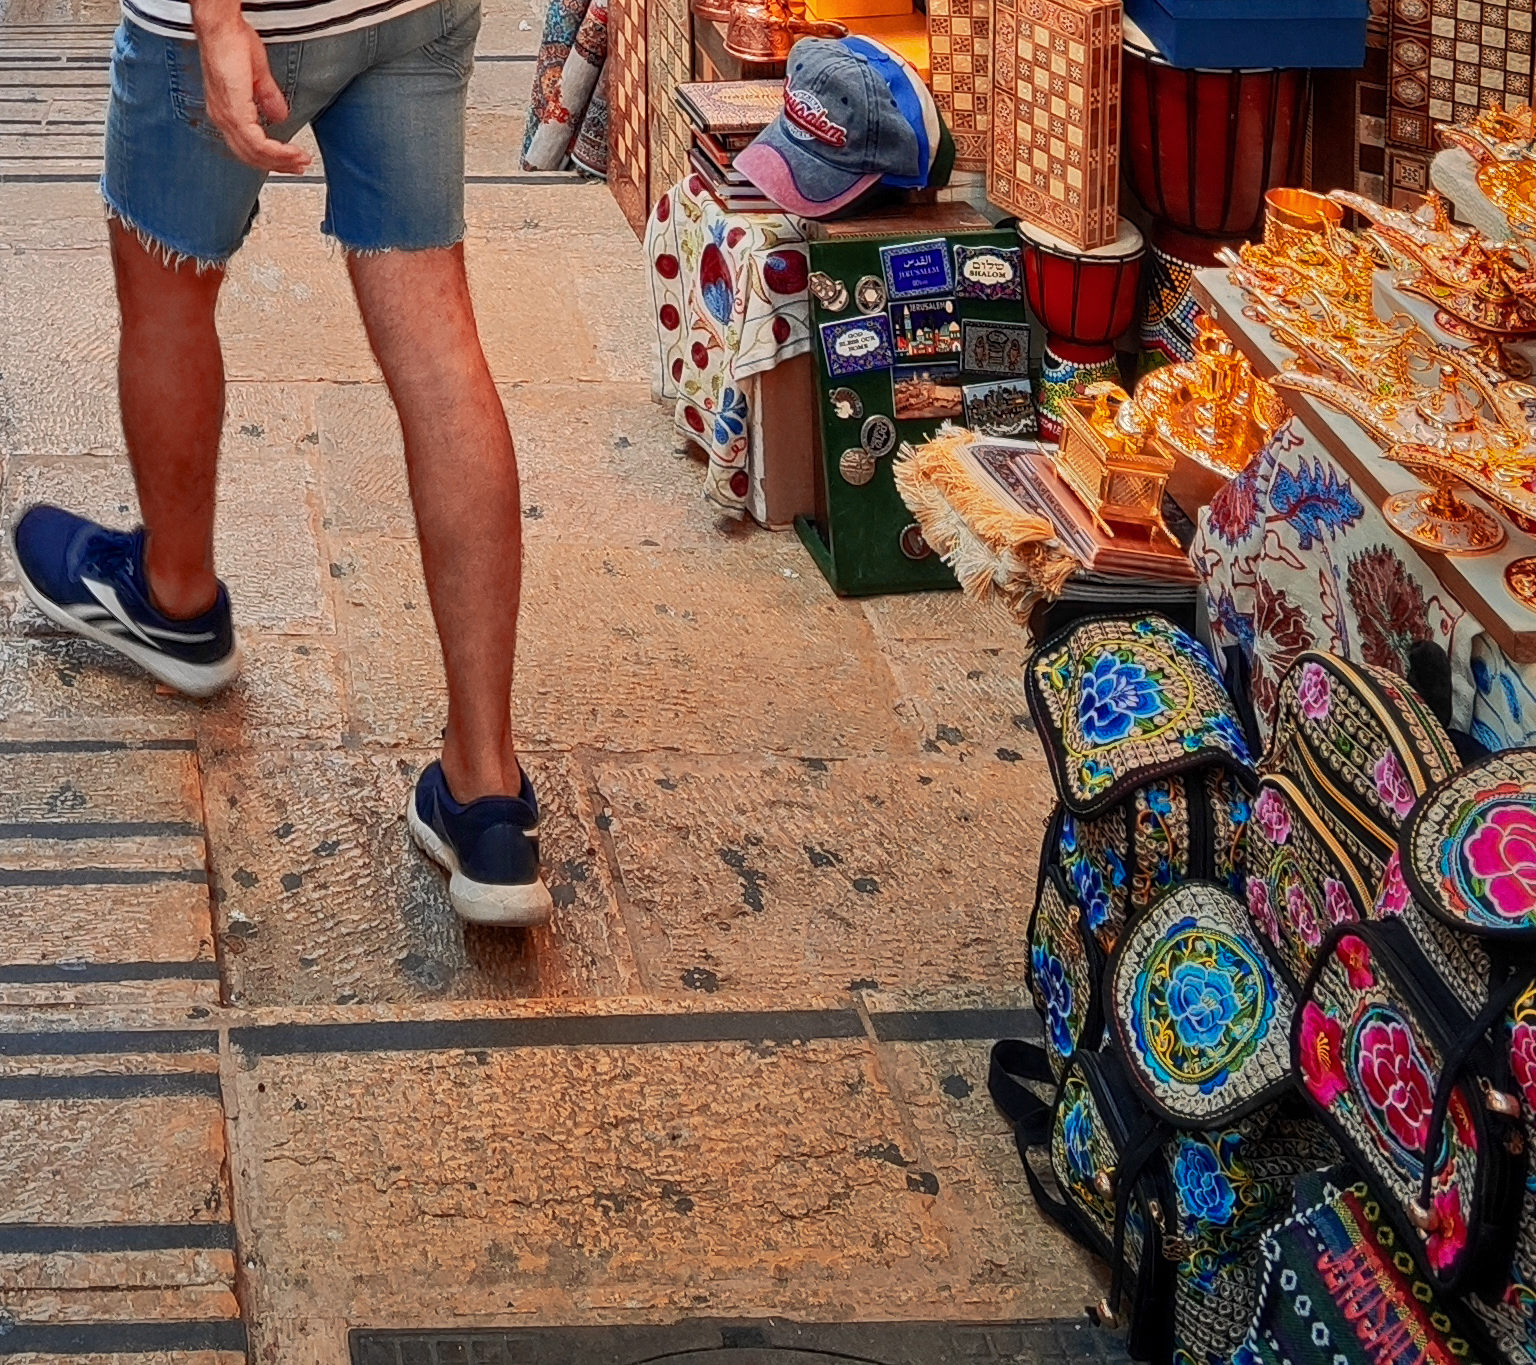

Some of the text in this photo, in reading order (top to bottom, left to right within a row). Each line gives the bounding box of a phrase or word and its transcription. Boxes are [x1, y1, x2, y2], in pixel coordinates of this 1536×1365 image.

[903, 254, 932, 268] القدس
[972, 259, 1005, 270] שלום
[898, 266, 940, 281] JERUSALEM
[969, 270, 1007, 279] SHALOM
[910, 301, 946, 312] JERUSALEM
[839, 335, 875, 347] BLESS OUR
[848, 343, 868, 352] HOME
[1052, 502, 1078, 531] Covenant
